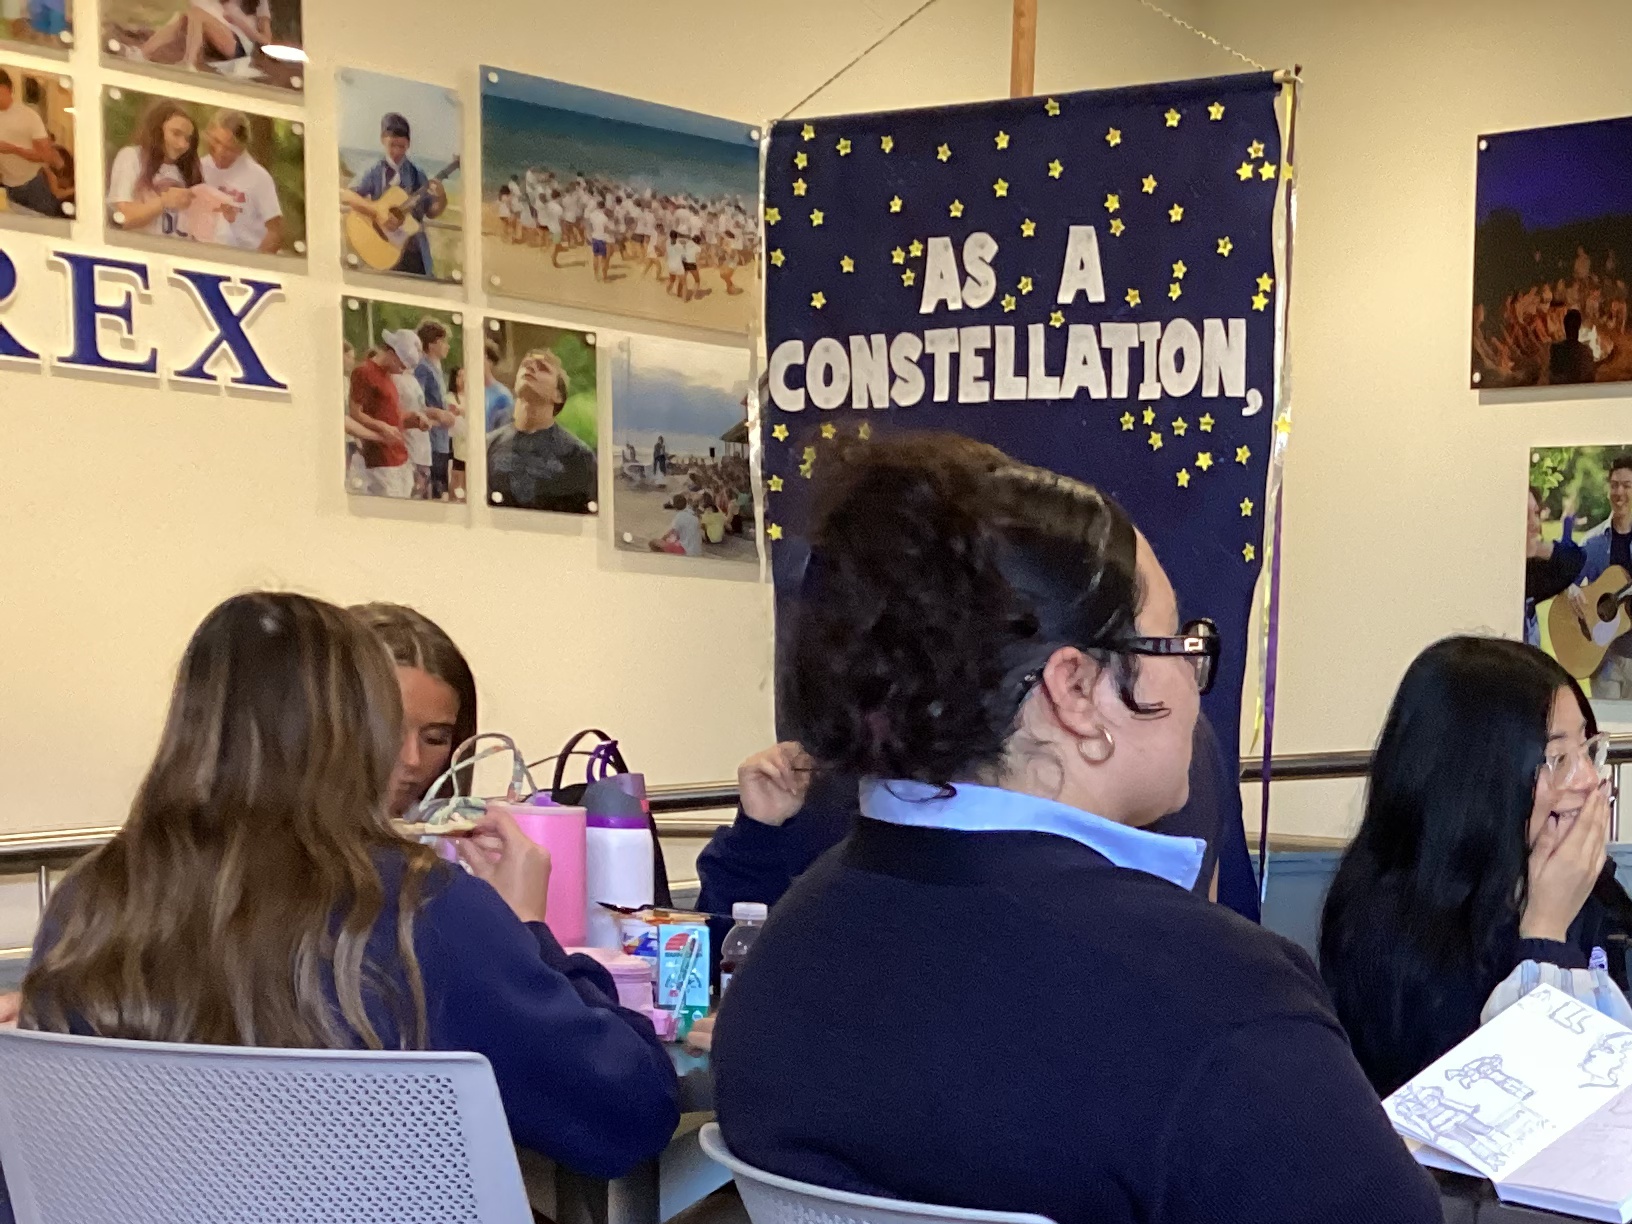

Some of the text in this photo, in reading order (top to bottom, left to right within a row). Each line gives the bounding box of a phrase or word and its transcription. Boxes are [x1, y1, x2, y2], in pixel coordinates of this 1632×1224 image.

[919, 224, 1106, 314] AS A
[767, 317, 1264, 417] CONSTELLATION,
